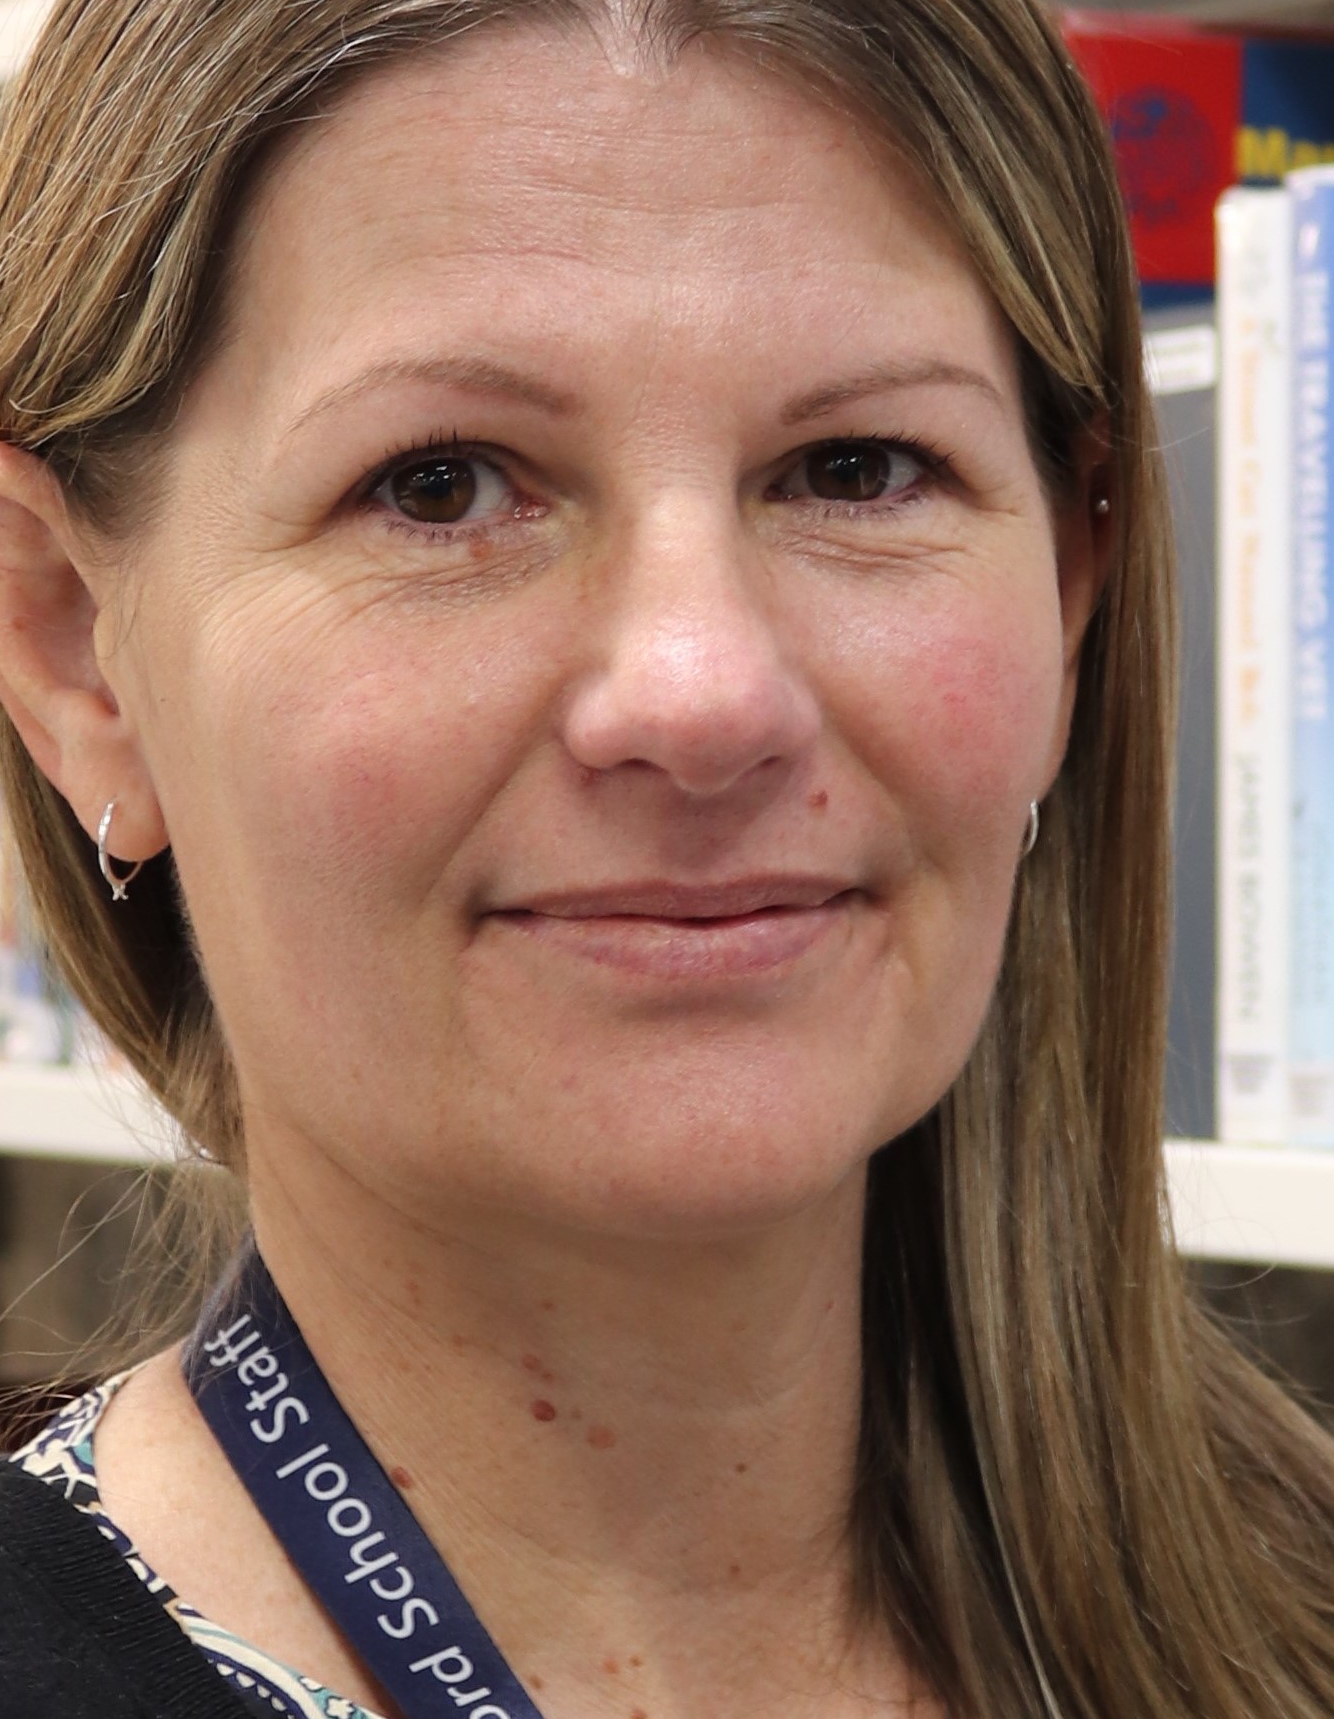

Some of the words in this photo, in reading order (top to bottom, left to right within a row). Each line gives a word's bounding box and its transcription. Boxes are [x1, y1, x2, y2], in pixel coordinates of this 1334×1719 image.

[1298, 270, 1330, 348] THE
[1298, 358, 1330, 630] TRAVELLING
[1298, 636, 1330, 722] VET
[1235, 750, 1264, 862] JAMES
[1235, 872, 1265, 1022] BOWEN
[204, 1314, 311, 1443] Staff
[275, 1443, 440, 1640] School
